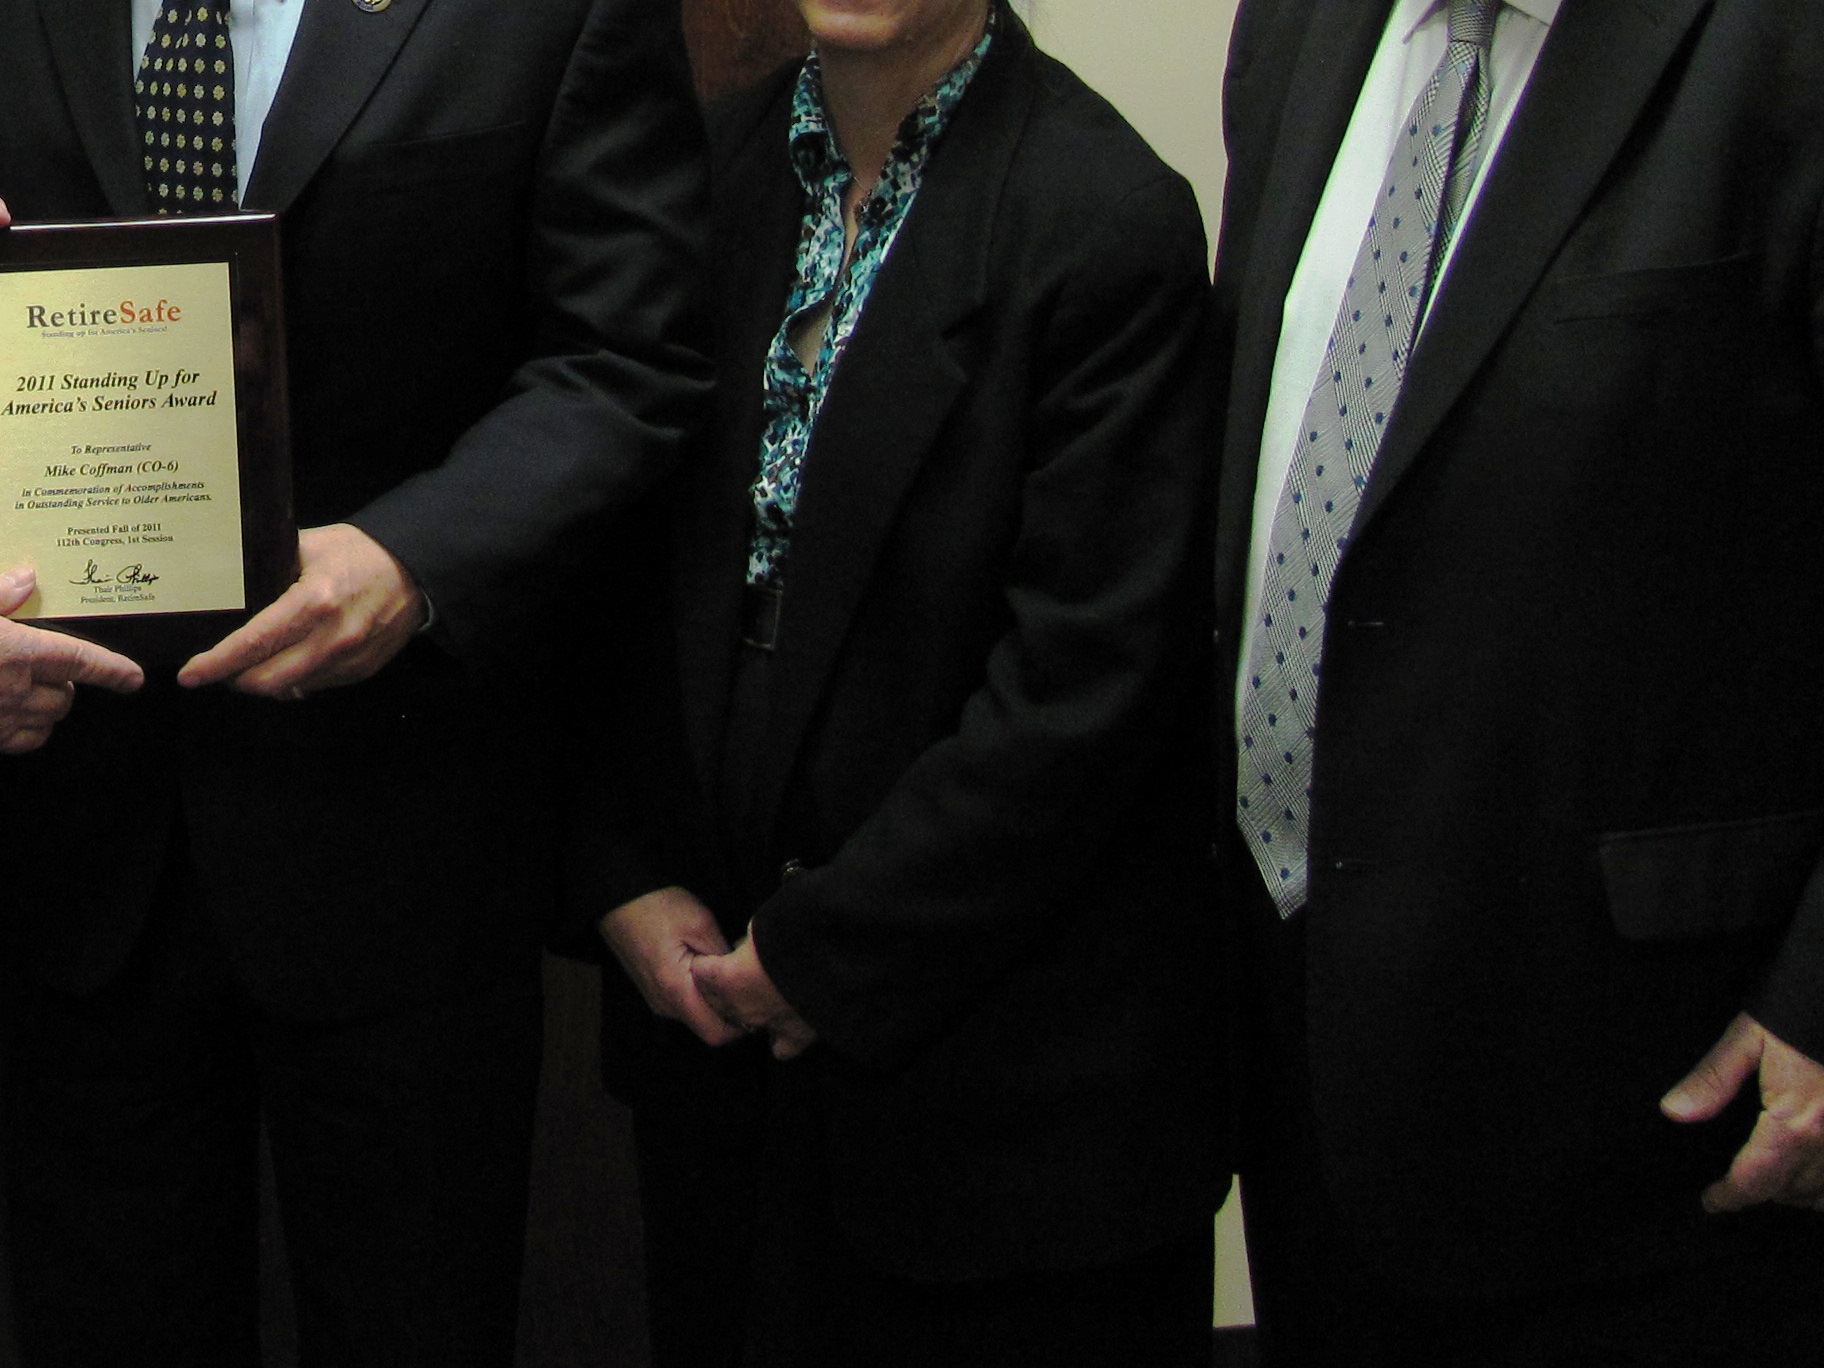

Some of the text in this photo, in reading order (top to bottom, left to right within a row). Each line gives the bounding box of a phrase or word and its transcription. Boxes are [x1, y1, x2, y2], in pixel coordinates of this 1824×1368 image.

[26, 299, 181, 328] RetireSafe
[16, 368, 200, 392] 2011 Standing Up for
[0, 390, 217, 417] America's Seniors Award
[71, 442, 152, 455] To Representative
[44, 460, 179, 478] Mike Coffman (CO-6)
[34, 485, 110, 497] Commemoration
[113, 484, 124, 495] of
[124, 481, 205, 493] Accomplishments
[15, 501, 24, 510] in
[27, 498, 84, 510] Outstanding
[85, 496, 119, 507] Service
[121, 496, 131, 505] to
[133, 495, 159, 505] Older
[67, 523, 161, 536] Presented Fall of 2011
[57, 534, 174, 547] 112th Congress, 1st Session
[115, 584, 142, 594] Phillips
